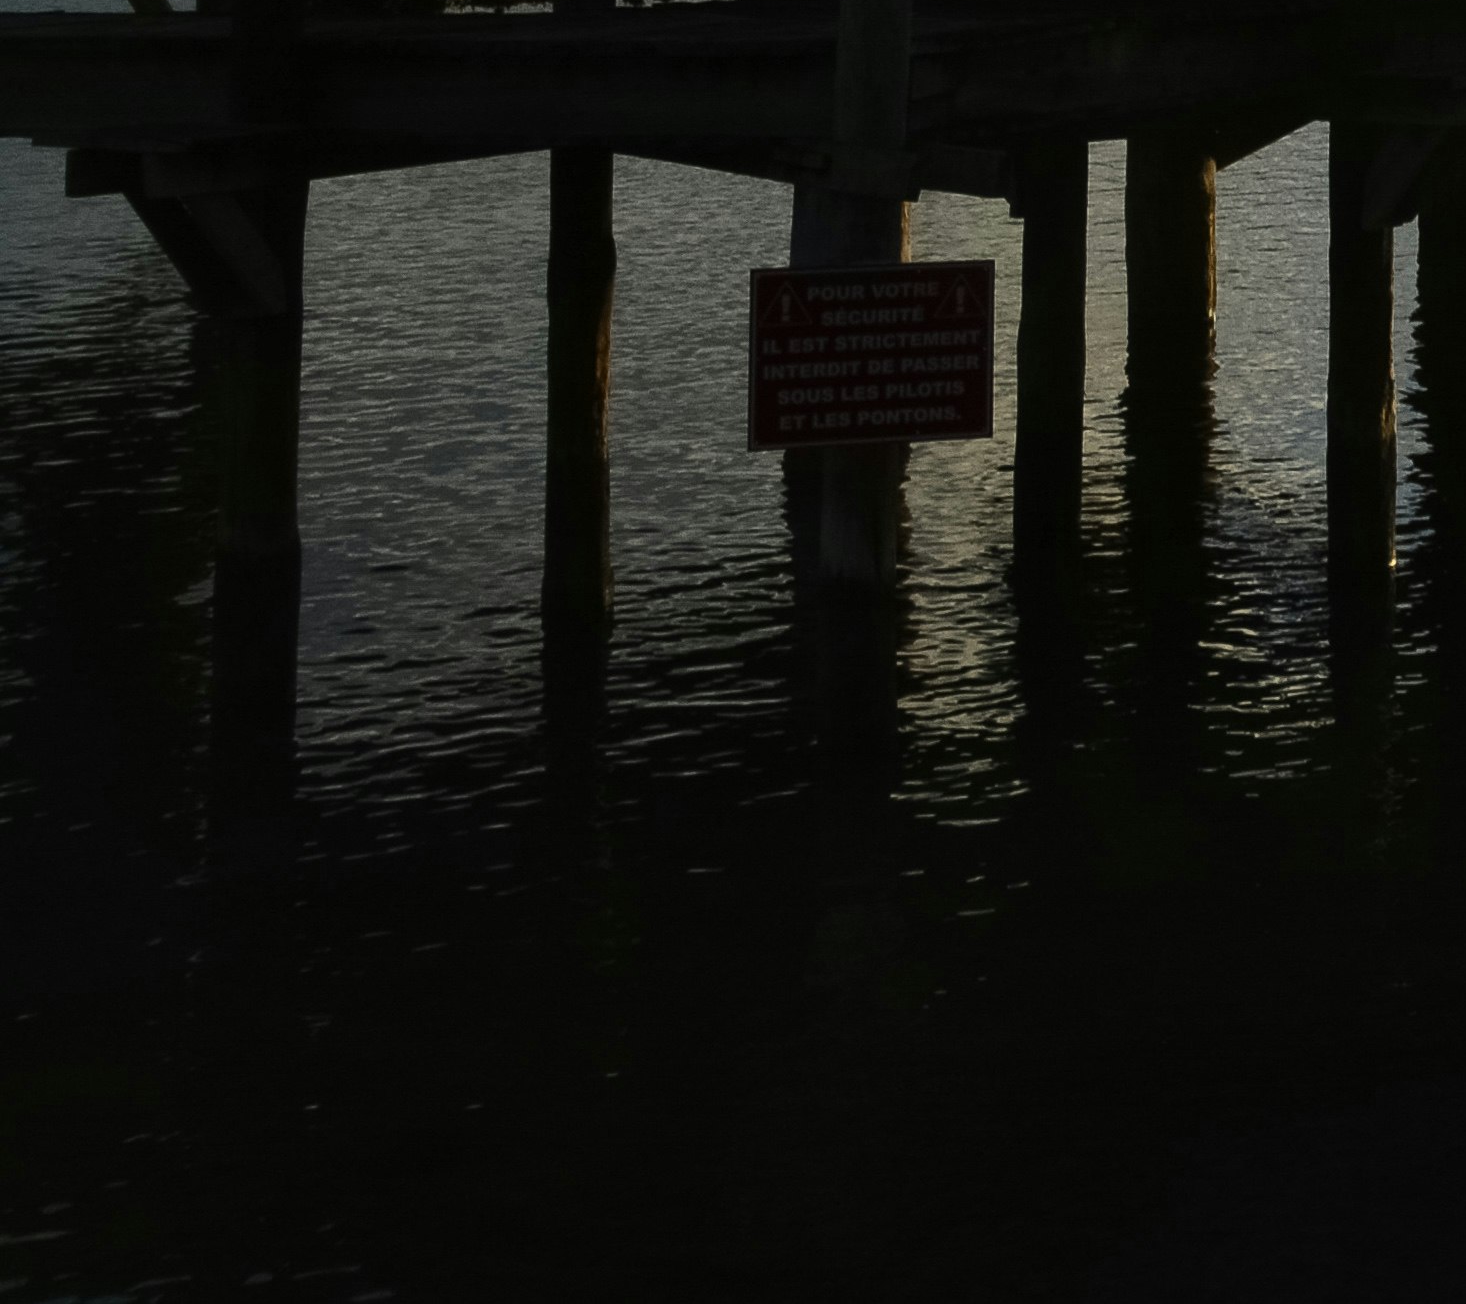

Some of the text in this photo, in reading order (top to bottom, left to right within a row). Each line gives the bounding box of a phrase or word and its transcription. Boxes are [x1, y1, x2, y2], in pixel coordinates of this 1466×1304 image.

[807, 282, 939, 302] POUR VOTRE
[820, 305, 924, 326] SÉCURITÉ
[762, 329, 980, 354] IL EST STRICTEMENT
[763, 354, 979, 380] INTERDIT DE PASSER
[777, 381, 965, 405] SOUS LES PILOTIS
[779, 405, 960, 431] ET LES PONTONS.
